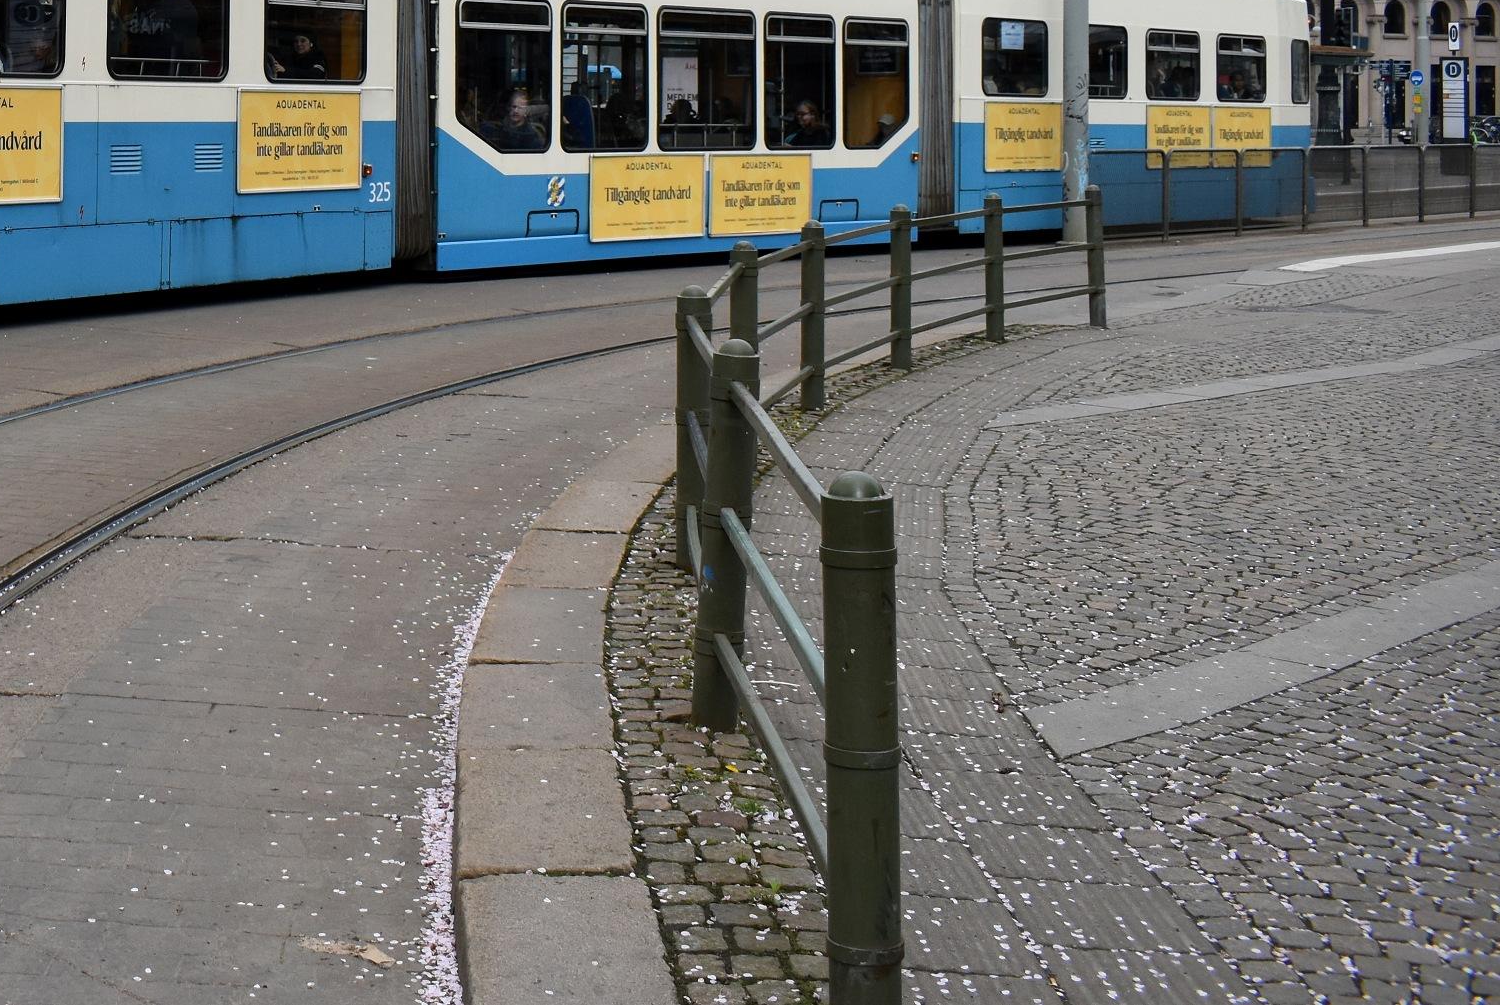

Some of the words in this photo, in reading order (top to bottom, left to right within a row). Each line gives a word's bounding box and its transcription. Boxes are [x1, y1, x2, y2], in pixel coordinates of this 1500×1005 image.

[275, 99, 327, 110] AQUADENTAL
[252, 122, 302, 138] Tandläkaren
[303, 122, 316, 137] för
[317, 122, 330, 140] dig
[332, 124, 348, 137] som
[256, 142, 272, 157] inte
[274, 141, 295, 160] gillar
[297, 141, 343, 156] tandläkaren
[626, 161, 673, 170] AQUADENTAL
[741, 161, 783, 169] AQUADENTAL
[368, 181, 391, 203] 325
[721, 180, 762, 192] Tandläkaren
[763, 179, 774, 191] för
[775, 180, 786, 194] dig
[786, 181, 801, 190] som
[604, 186, 650, 205] Tillgänglig
[652, 185, 691, 200] tandvård
[725, 195, 738, 207] inte
[739, 195, 756, 210] gillar
[758, 195, 797, 206] tandläkaren
